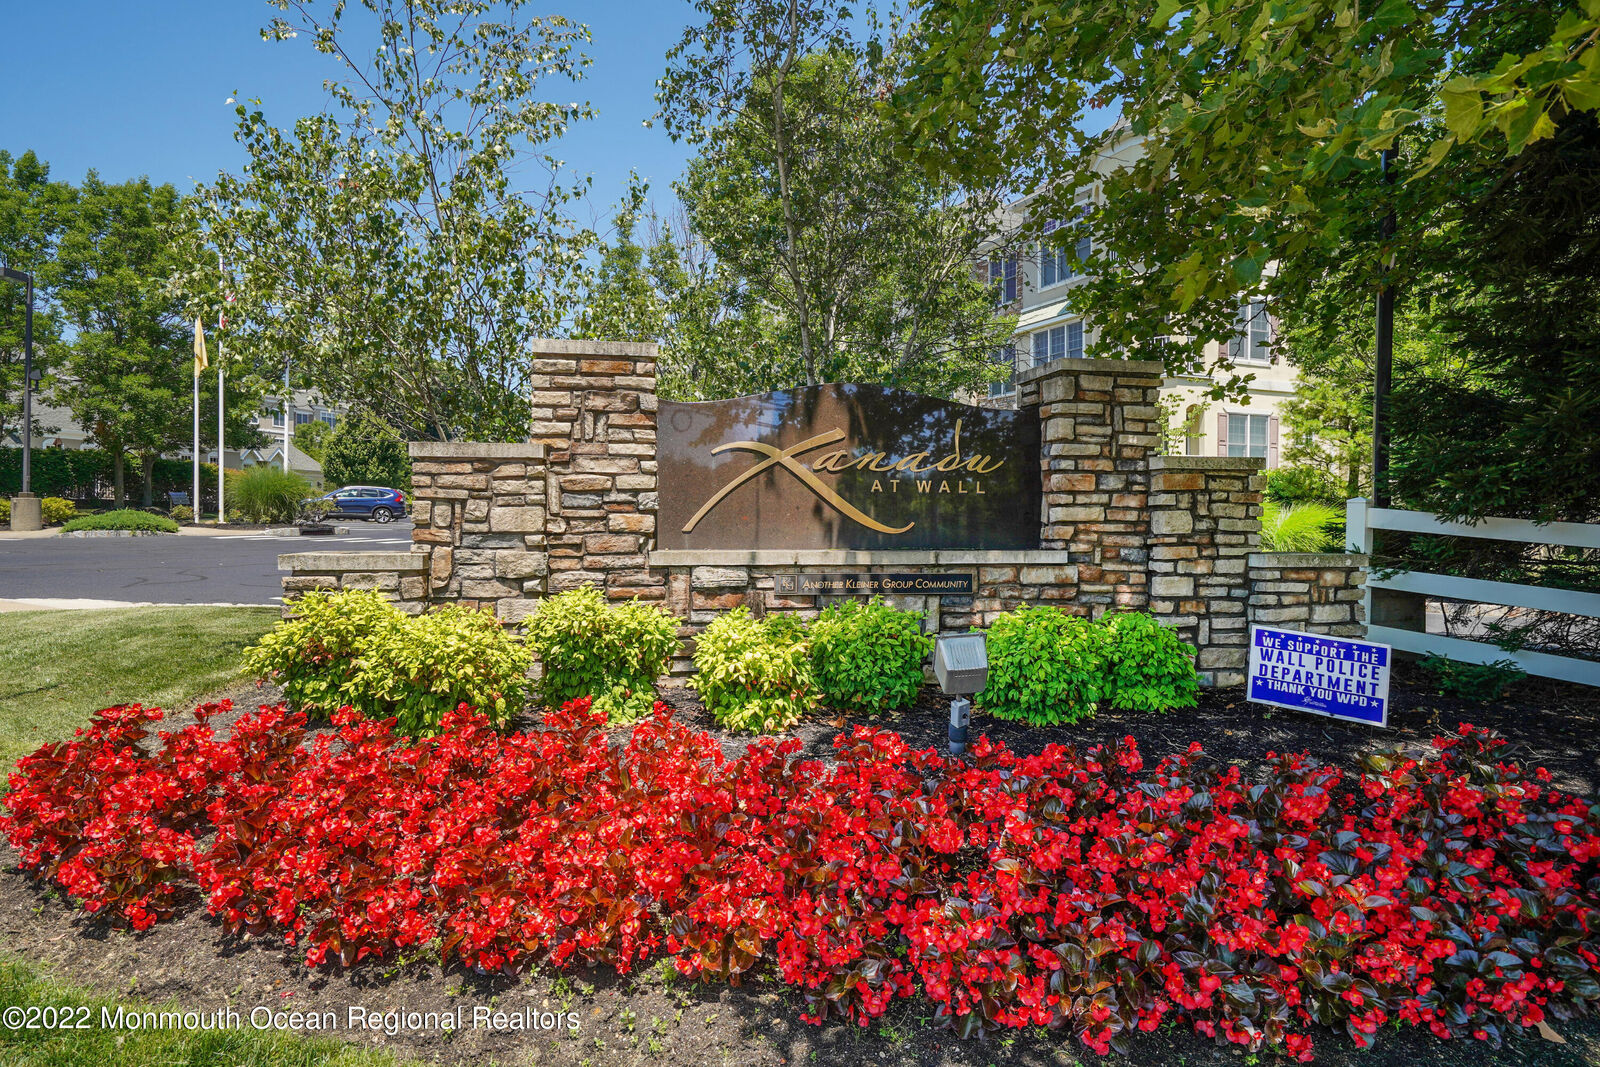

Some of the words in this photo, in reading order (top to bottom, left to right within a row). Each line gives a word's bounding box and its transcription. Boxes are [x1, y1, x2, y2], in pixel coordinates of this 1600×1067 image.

[681, 418, 1005, 534] Xanadu
[870, 479, 900, 493] AT
[916, 479, 986, 495] WALL
[1260, 647, 1306, 668] WALL
[1315, 657, 1380, 681] POLICE
[1262, 636, 1281, 649] WE
[1287, 640, 1346, 659] SUPPORT
[1352, 650, 1379, 664] THE
[1258, 663, 1380, 697] DEPARTMENT
[1267, 679, 1306, 696] THANK
[1308, 687, 1334, 701] YOU
[1336, 692, 1368, 707] WPD
